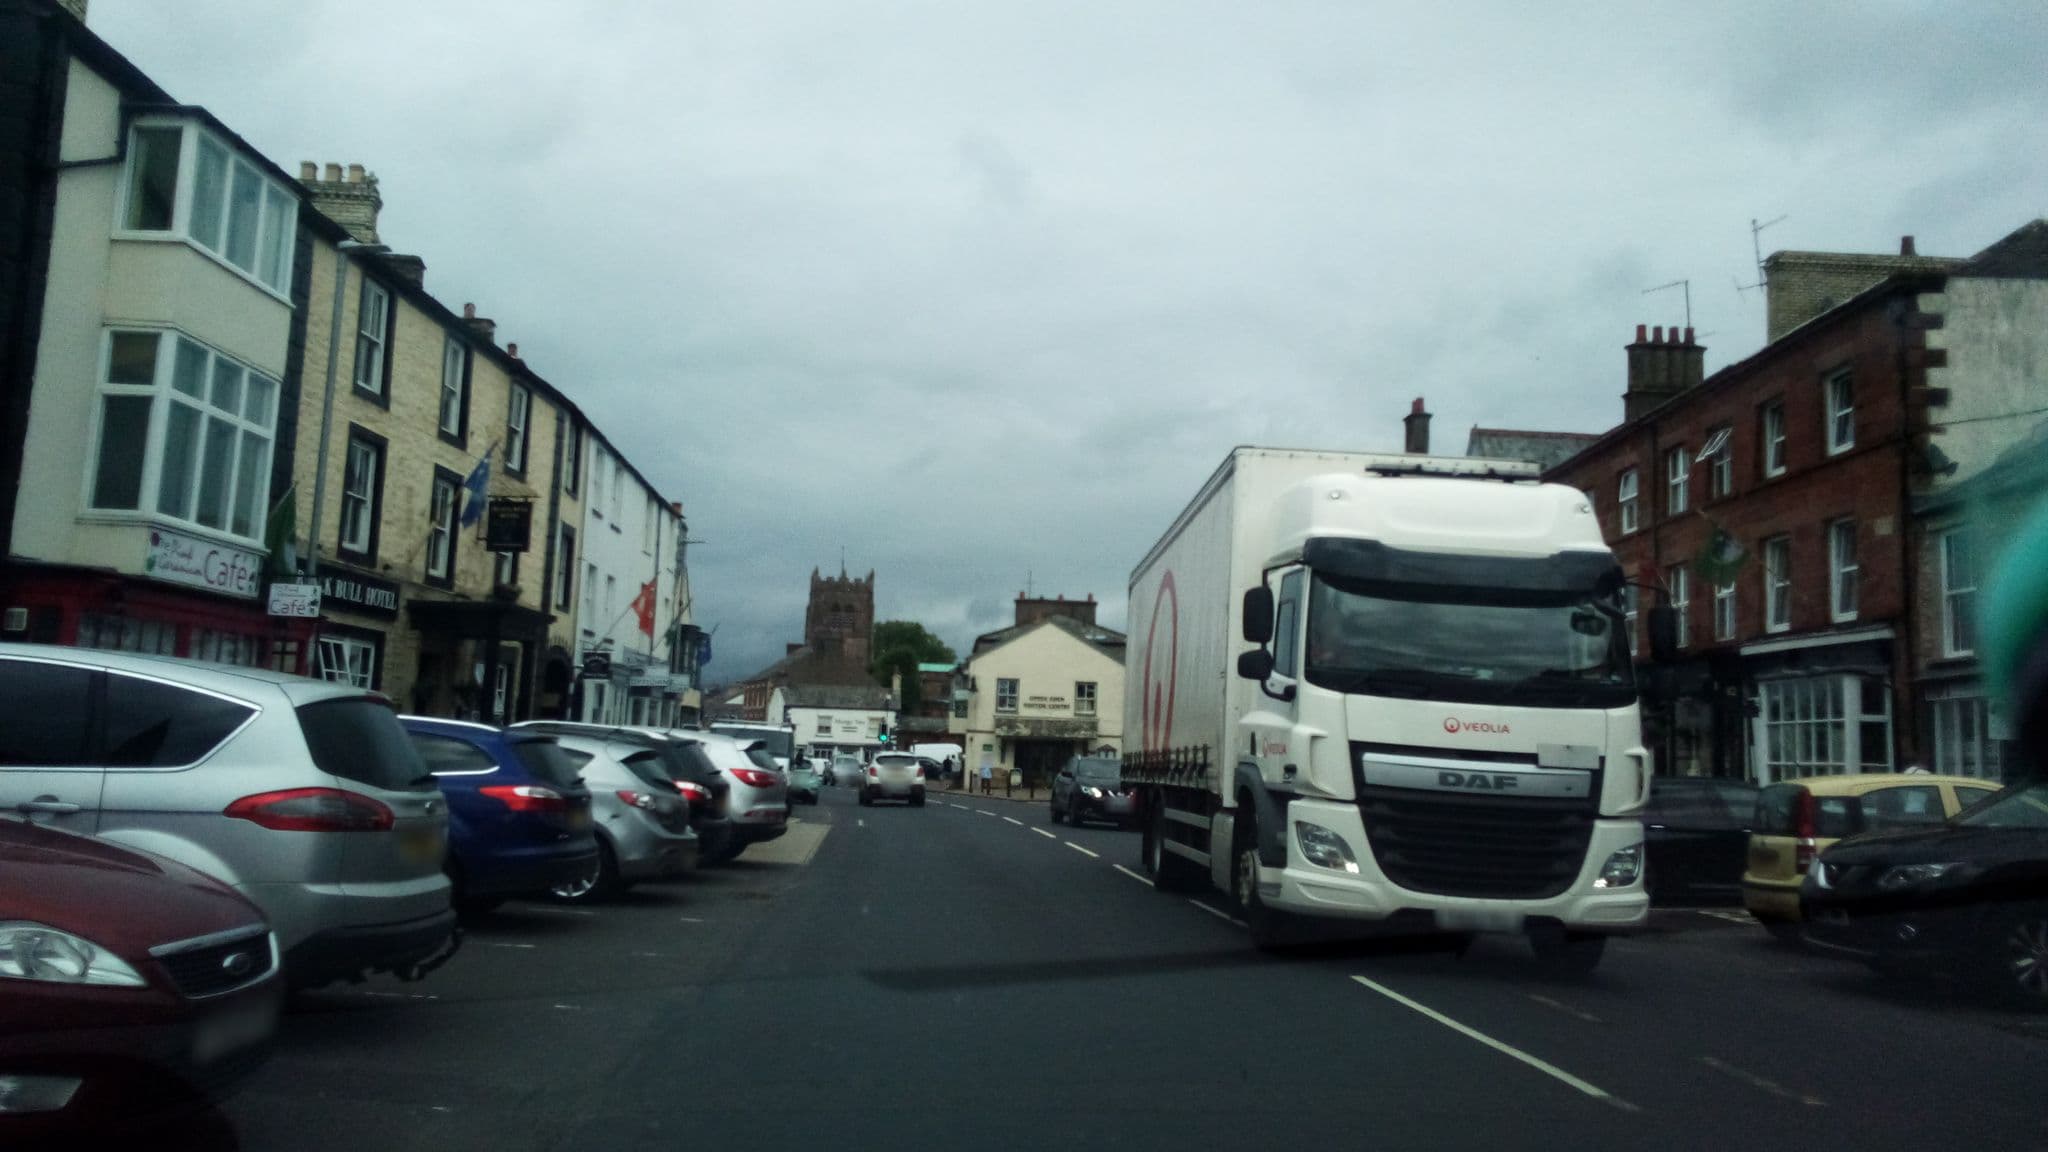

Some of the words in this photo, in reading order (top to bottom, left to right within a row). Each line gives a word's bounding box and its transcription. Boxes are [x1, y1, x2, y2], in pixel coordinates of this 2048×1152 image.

[204, 549, 248, 591] Café
[335, 579, 363, 603] BULL
[365, 586, 397, 610] HOTEL
[270, 598, 307, 616] Café
[1463, 722, 1511, 734] VEOLIA
[1438, 772, 1518, 790] DAF
